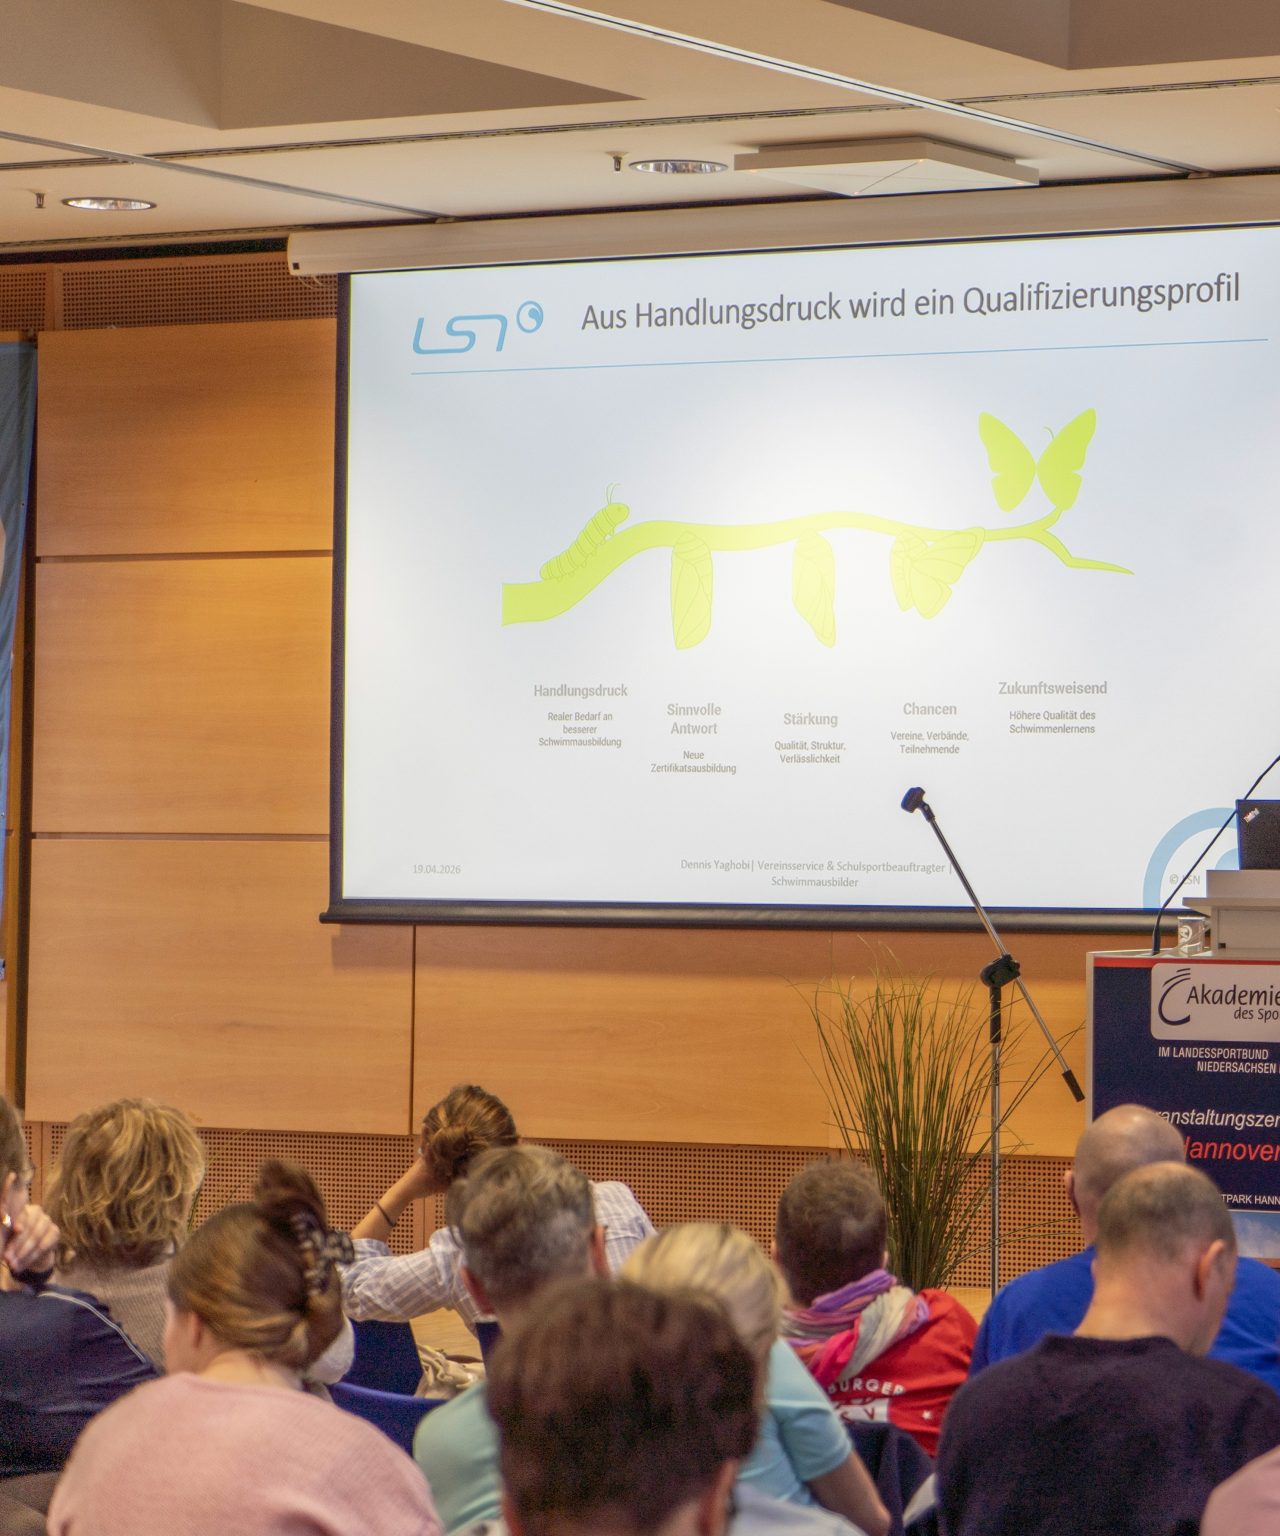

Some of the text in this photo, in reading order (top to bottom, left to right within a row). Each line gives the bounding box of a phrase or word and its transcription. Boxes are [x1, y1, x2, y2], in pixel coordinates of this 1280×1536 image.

[580, 272, 1240, 331] Aus Handlungsdruck wird ein Qualifizierungsprofil
[533, 684, 628, 699] Handlungsdruck
[998, 681, 1108, 695] Zukunftsweisend
[666, 703, 722, 716] Sinnvolle
[902, 702, 957, 716] Chancen
[547, 712, 613, 721] Realer Bedarf an
[783, 712, 838, 728] Stärkung
[1009, 710, 1096, 721] Höhere Qualität des
[562, 725, 597, 734] besserer
[670, 722, 718, 734] Antwort
[1009, 724, 1096, 734] Schwimmenlernens
[890, 731, 969, 742] Vereine, Verbände,
[538, 738, 622, 748] Schwimmausbildung
[774, 741, 846, 752] Qualität, Struktur,
[899, 744, 960, 754] Teilnehmende
[683, 751, 705, 759] Neue
[779, 753, 841, 764] Verlässlichkeit
[650, 764, 737, 775] Zertifikatsausbildung
[412, 863, 462, 875] 19.04.2026
[680, 859, 712, 870] Dennis
[757, 861, 824, 871] Vereinsservice
[826, 861, 835, 871] &
[837, 861, 946, 874] Schulsportbeauftragter
[771, 876, 859, 888] Schwimmausbilder
[1233, 1007, 1254, 1020] des
[1158, 1046, 1270, 1060] IM LANDESSPORTBUND
[1196, 1061, 1277, 1074] NIEDERSACHSEN
[1220, 1193, 1253, 1205] TPARK
